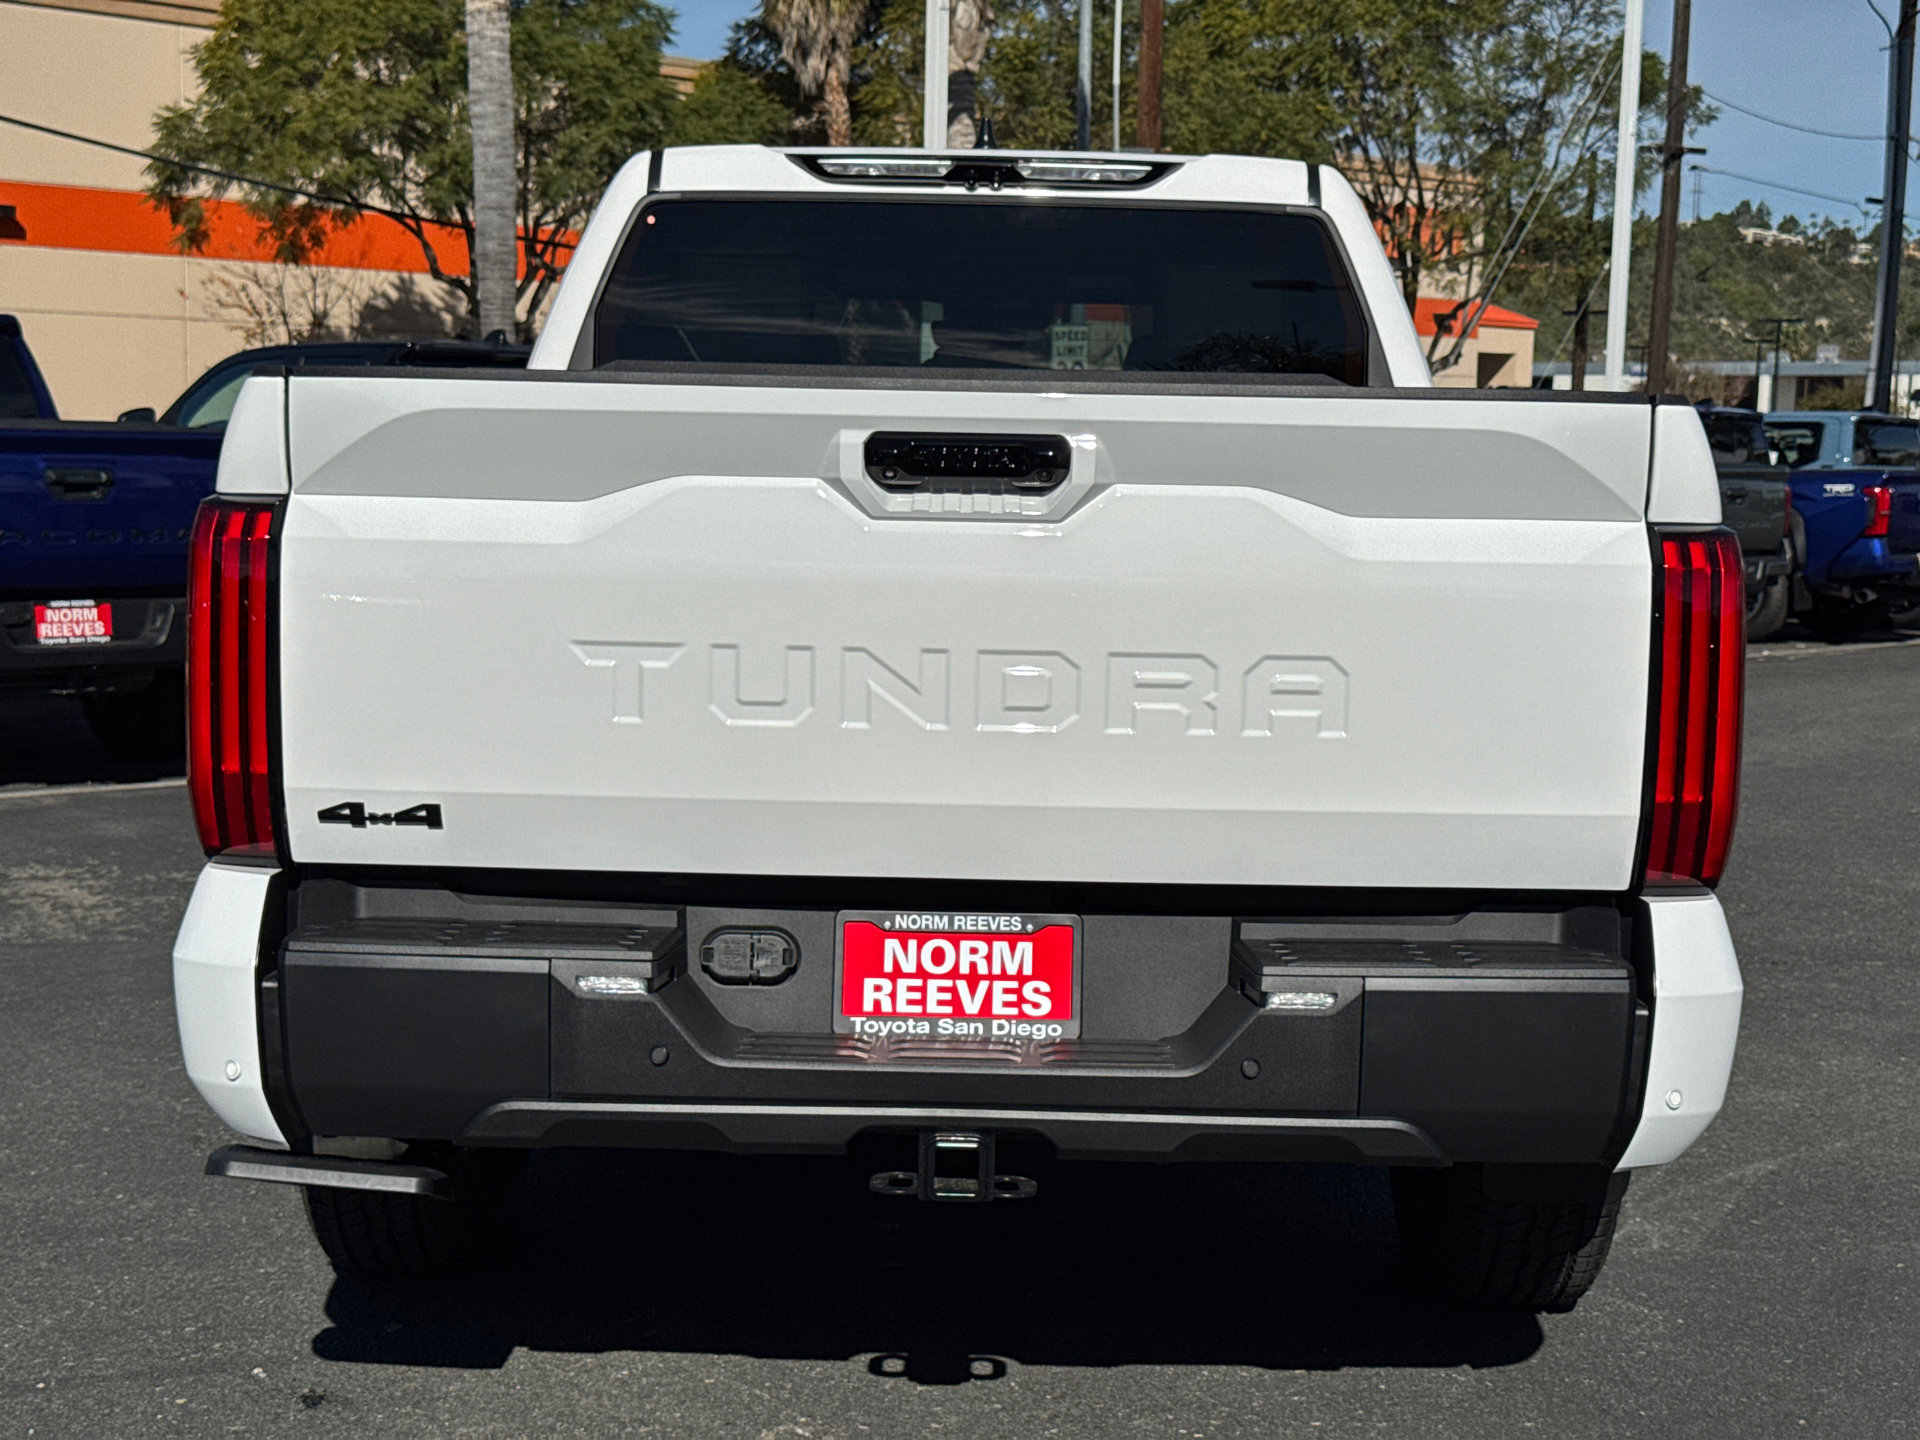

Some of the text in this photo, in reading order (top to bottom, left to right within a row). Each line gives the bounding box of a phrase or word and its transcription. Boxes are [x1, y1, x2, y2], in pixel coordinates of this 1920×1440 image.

[1055, 330, 1087, 341] SPEED
[1056, 345, 1084, 357] LIMIT
[46, 607, 98, 622] NORM
[40, 621, 106, 637] REEVES
[569, 640, 1350, 738] TUNDRA
[894, 914, 1022, 931] NORM REEVES
[883, 938, 1034, 976] NORM
[862, 977, 1052, 1017] REEVES
[849, 1016, 1062, 1040] Toyota San Diego
